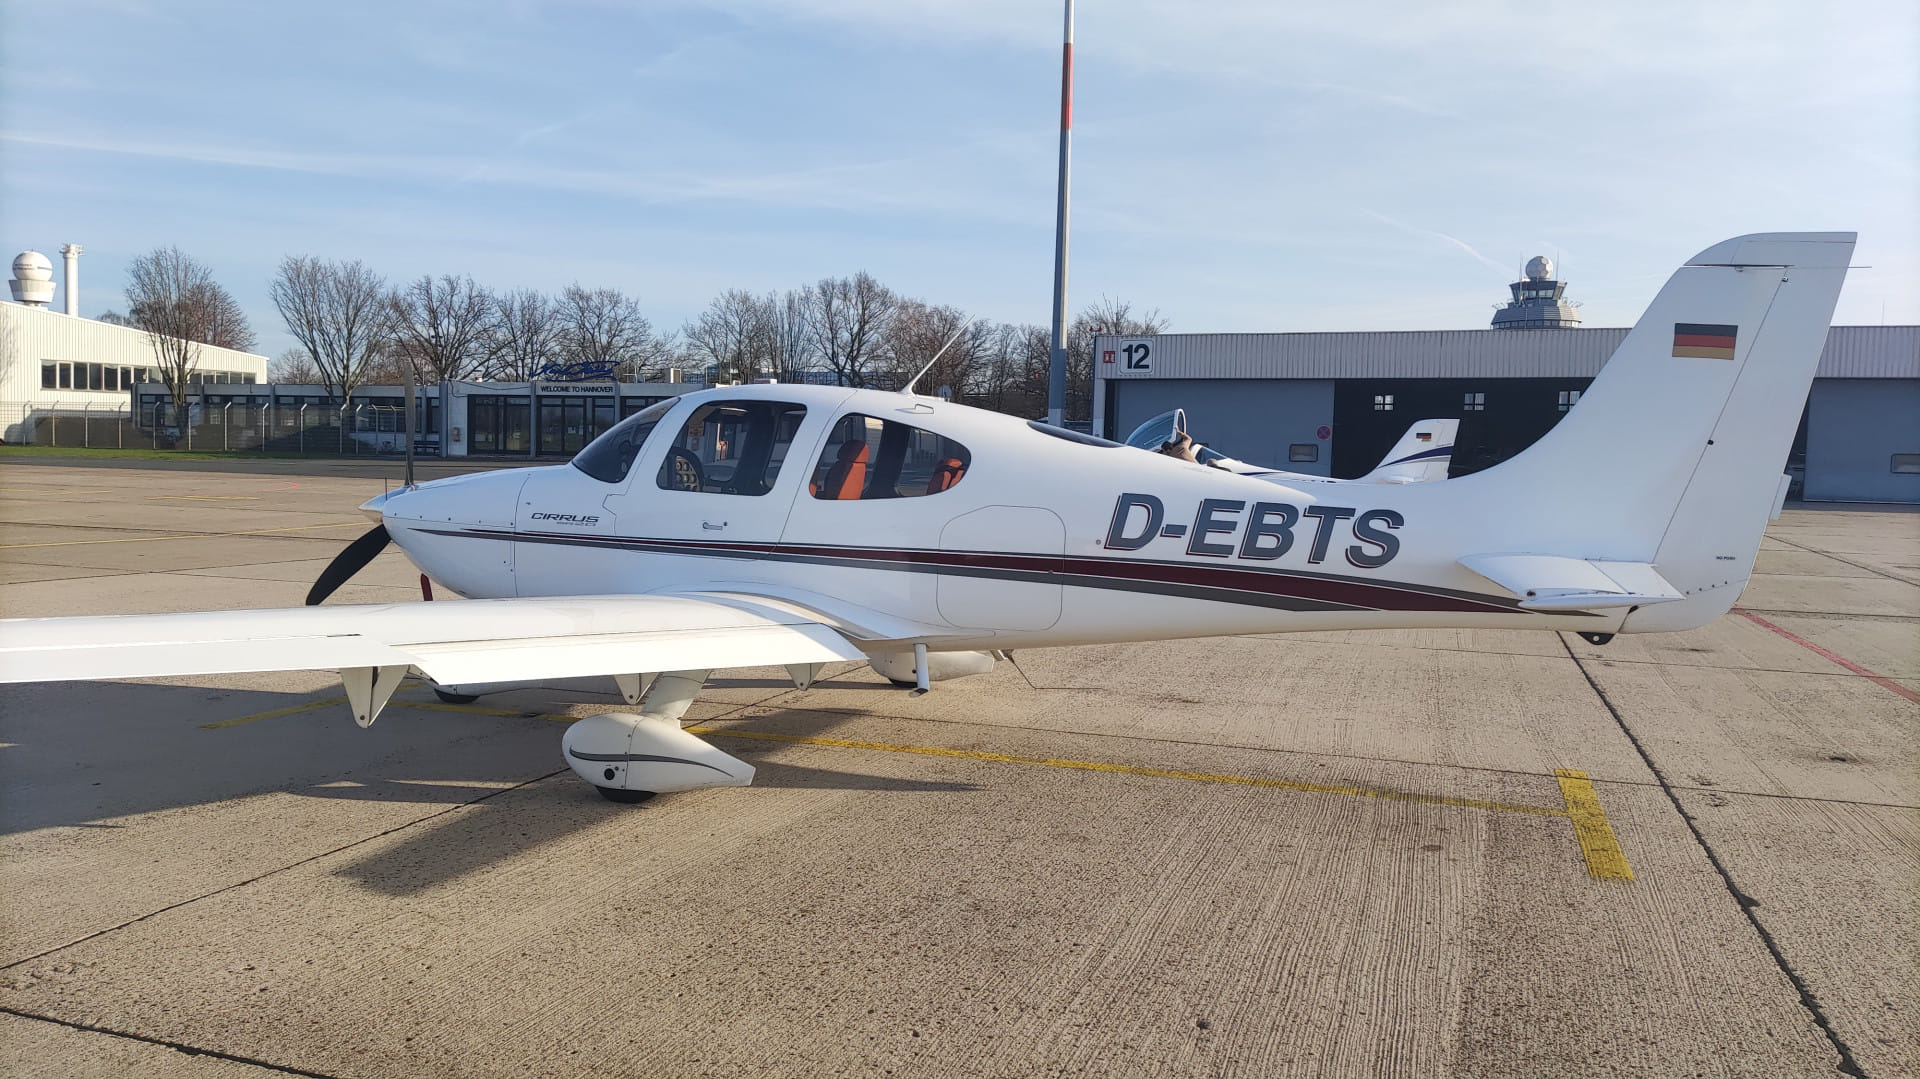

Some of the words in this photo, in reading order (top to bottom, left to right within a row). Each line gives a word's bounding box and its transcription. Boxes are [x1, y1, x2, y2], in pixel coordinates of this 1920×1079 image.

[1122, 344, 1150, 369] 12
[531, 512, 600, 522] CIRRUS
[1104, 492, 1405, 568] D-EBTS
